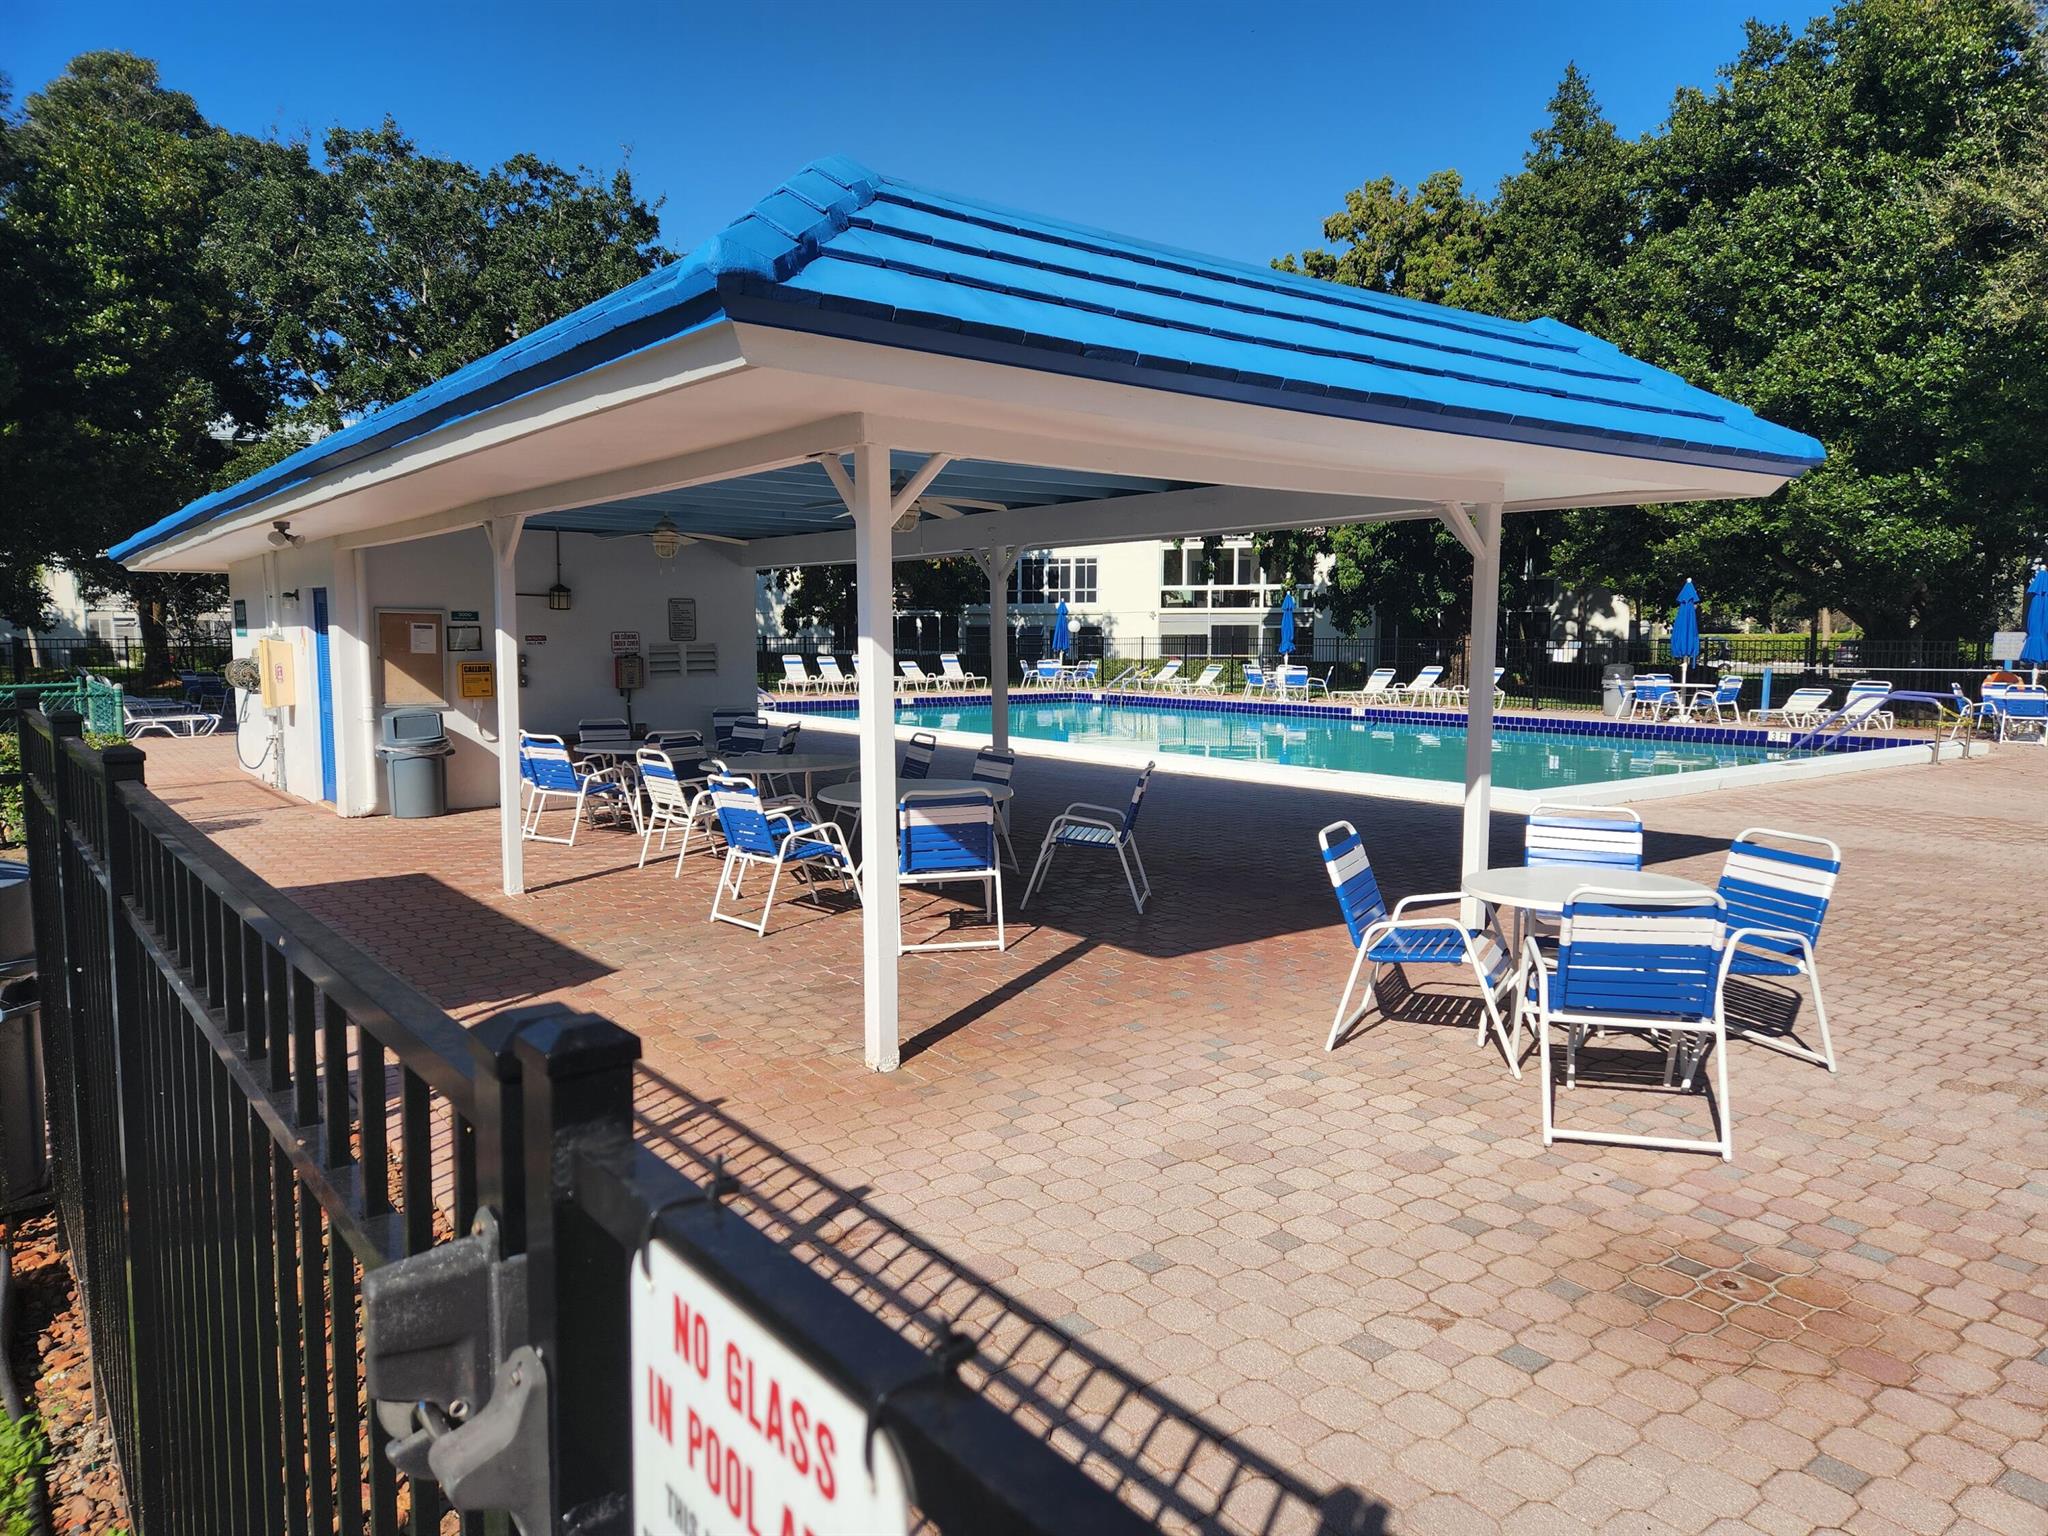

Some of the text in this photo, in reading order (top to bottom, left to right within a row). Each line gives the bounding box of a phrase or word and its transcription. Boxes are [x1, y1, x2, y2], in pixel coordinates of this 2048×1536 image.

[1771, 732, 1789, 741] 3 FT
[648, 1365, 761, 1536] IN POOL
[674, 1293, 836, 1501] NO GLASS
